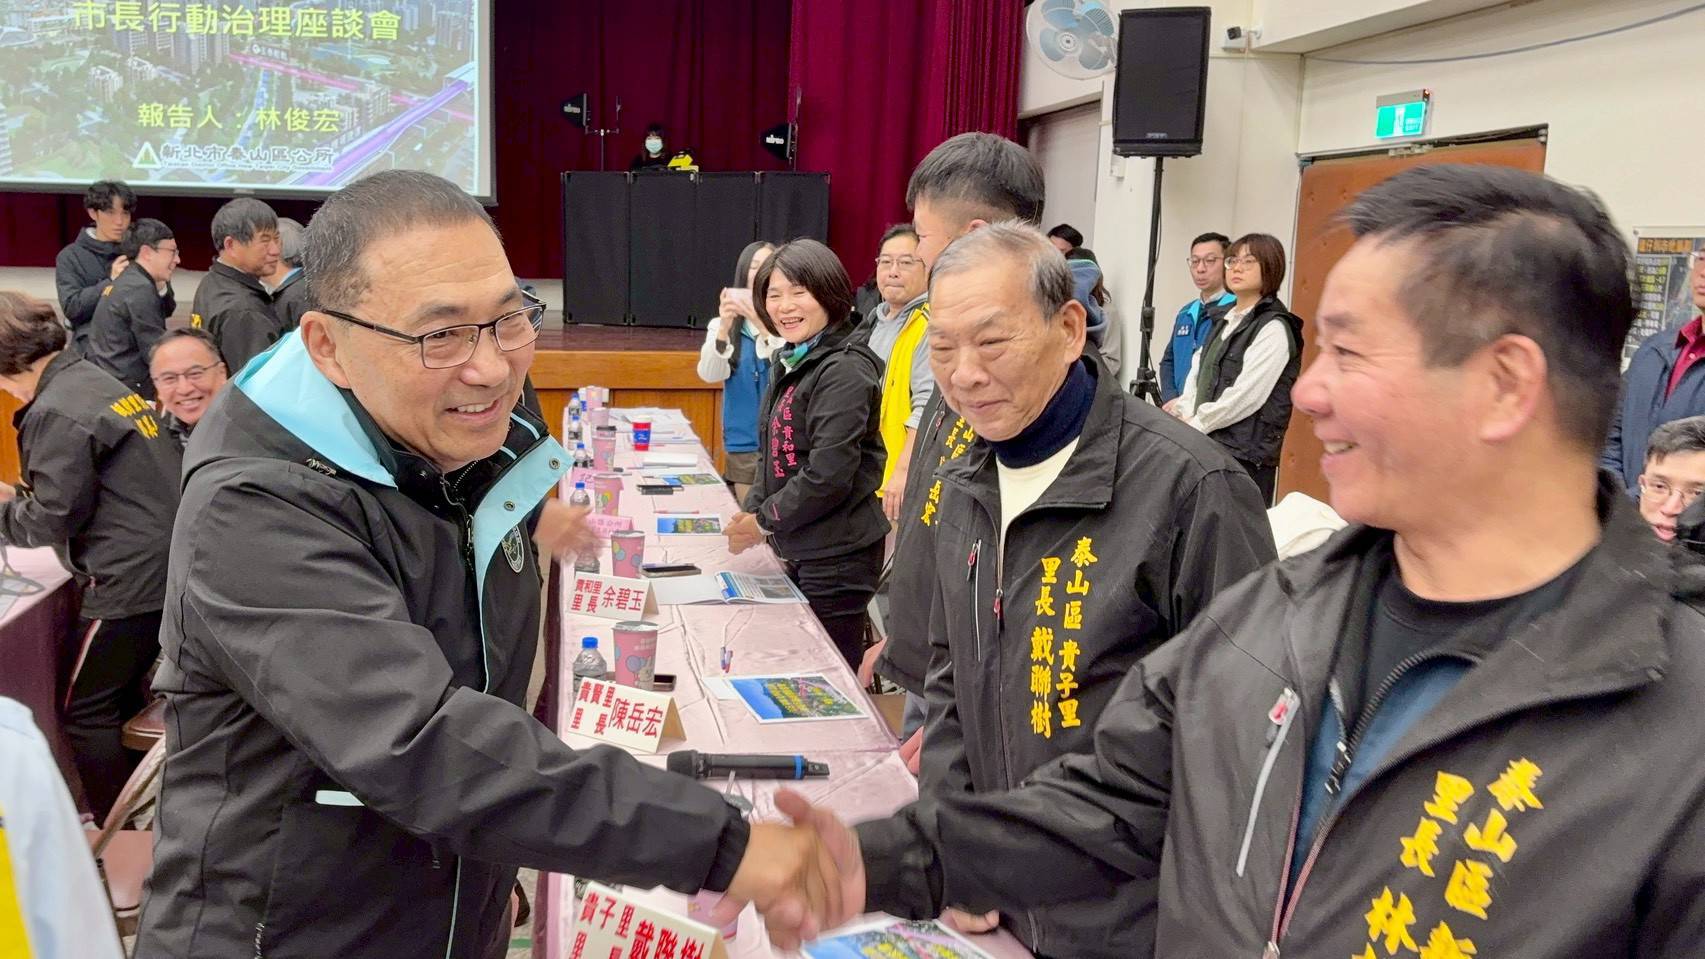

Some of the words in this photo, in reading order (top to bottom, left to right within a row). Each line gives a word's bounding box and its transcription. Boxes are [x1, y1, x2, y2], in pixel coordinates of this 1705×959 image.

[72, 0, 402, 41] 市長行動治理座談會
[137, 103, 341, 132] 報告人：林俊宏
[160, 144, 335, 164] 新北市泰山區公所
[601, 585, 645, 612] 余碧玉
[607, 697, 664, 738] 陳岳宏
[579, 890, 636, 940] 貴子里
